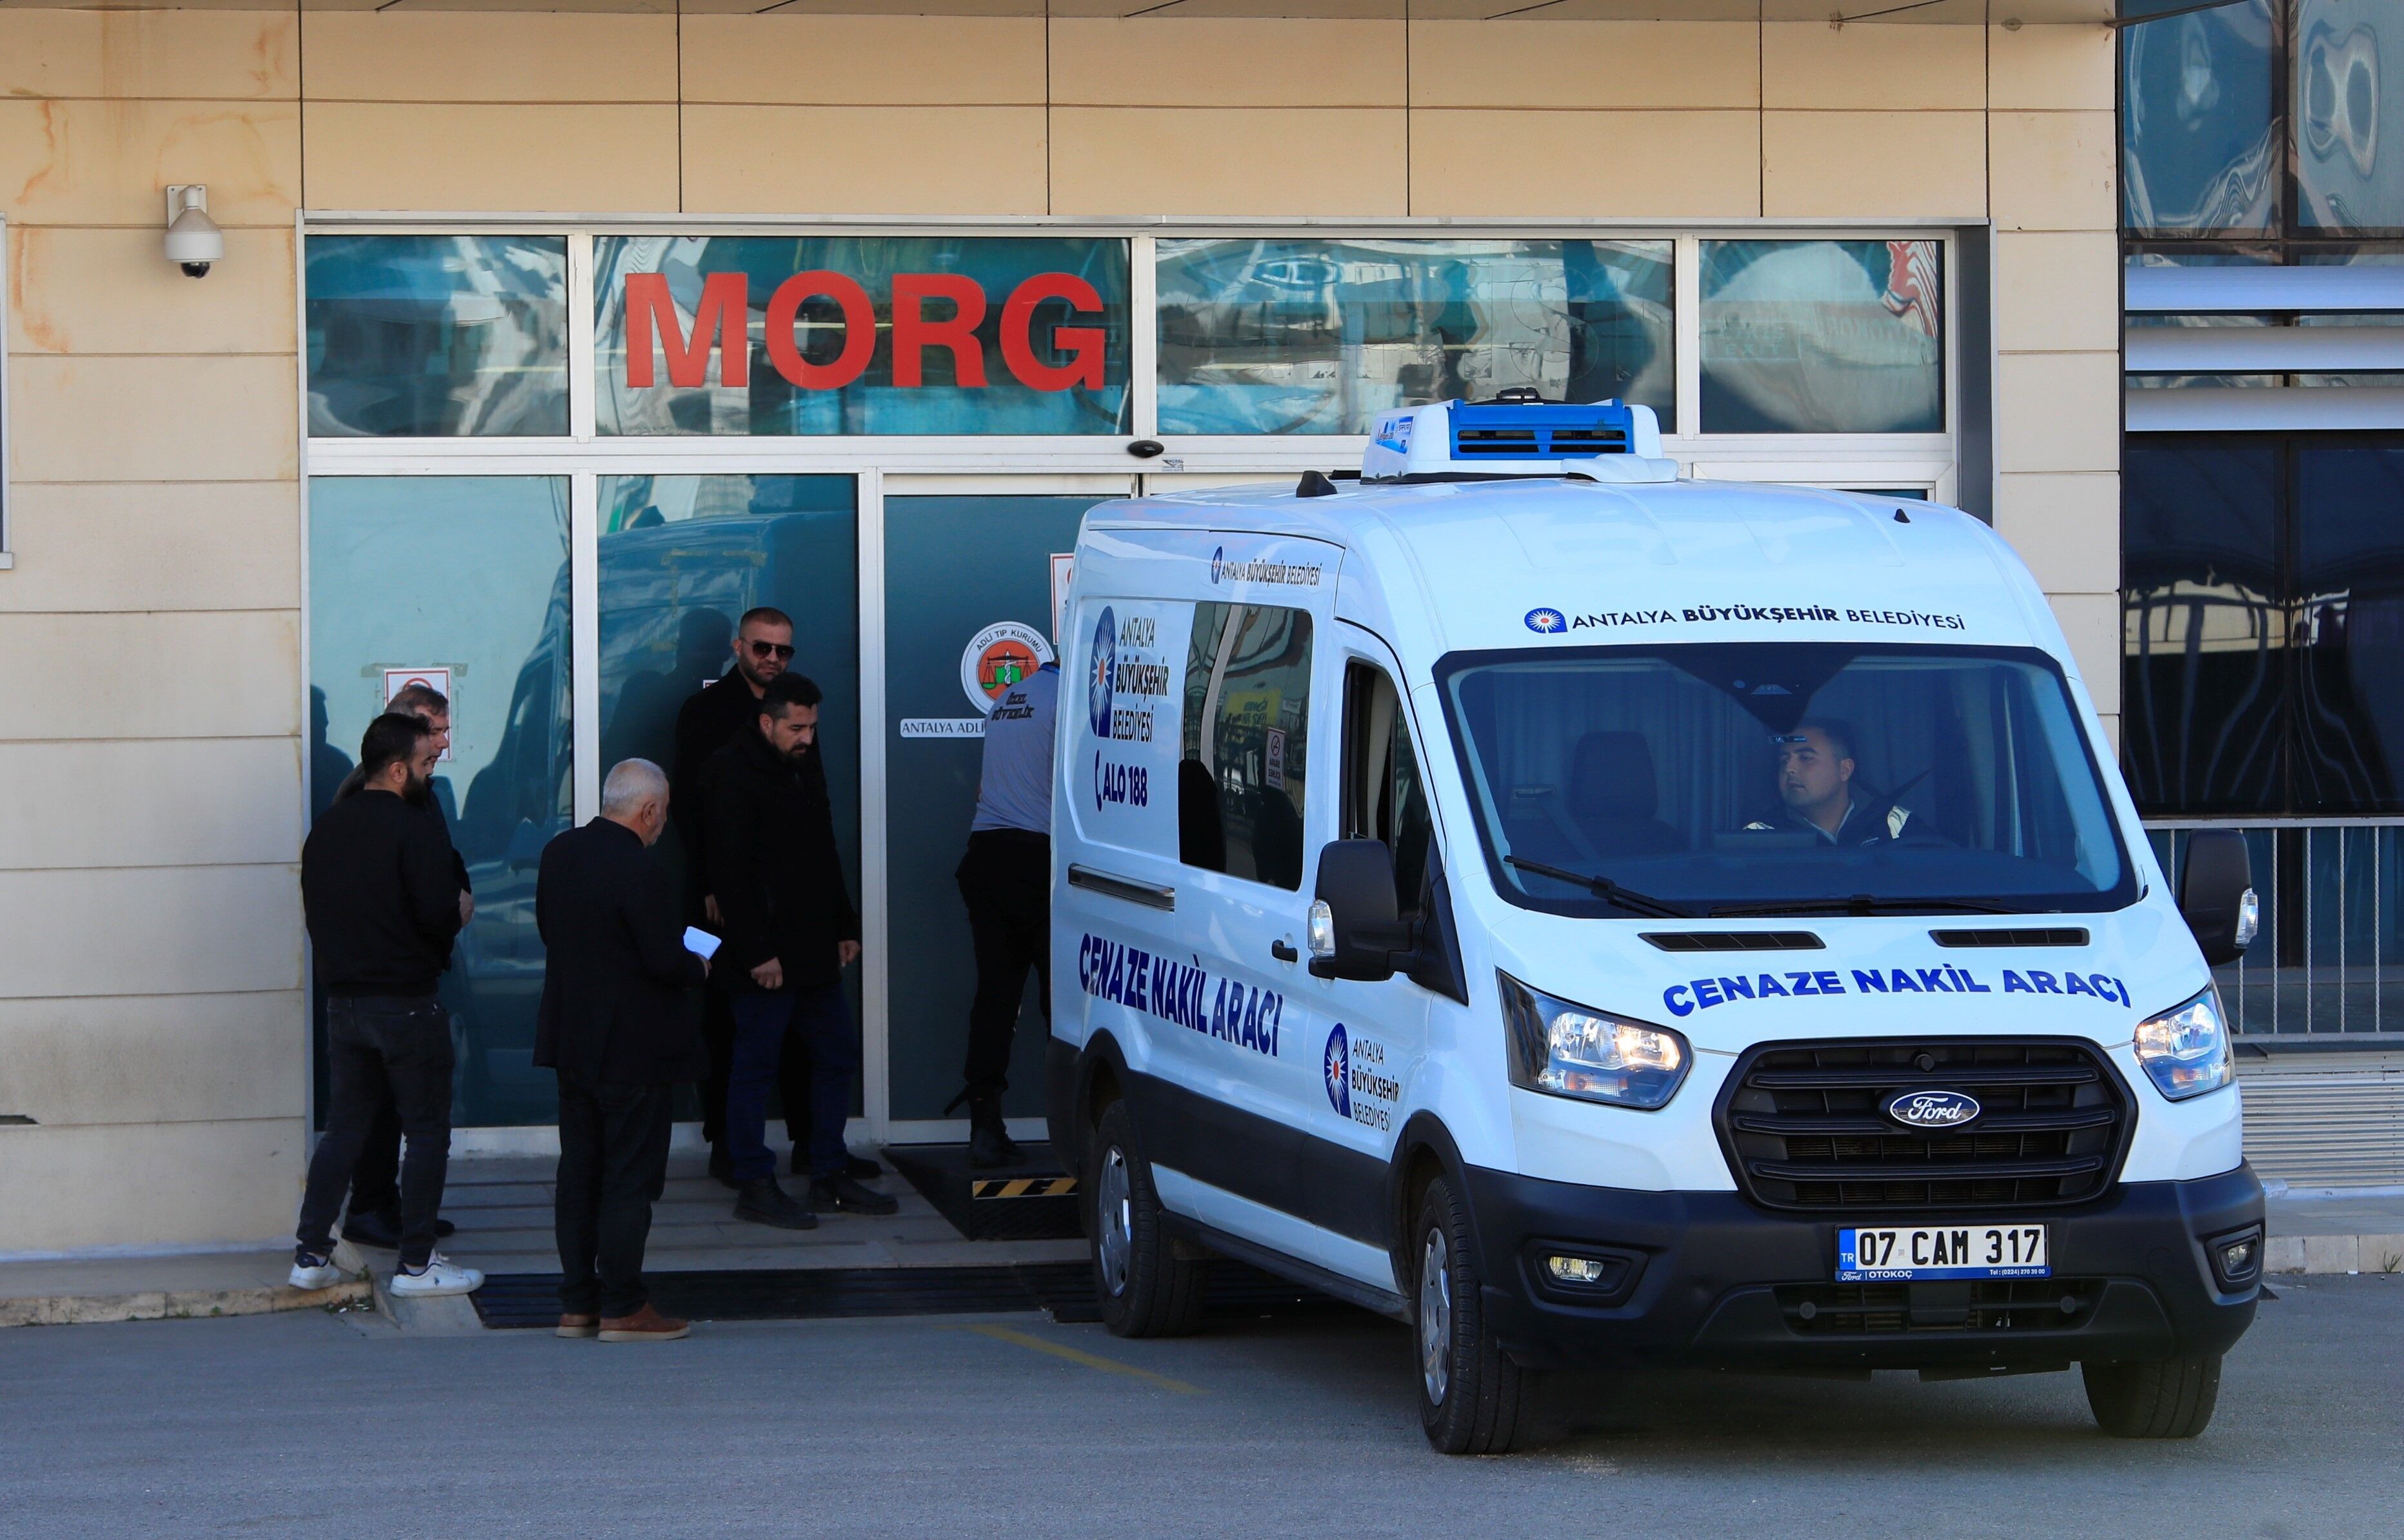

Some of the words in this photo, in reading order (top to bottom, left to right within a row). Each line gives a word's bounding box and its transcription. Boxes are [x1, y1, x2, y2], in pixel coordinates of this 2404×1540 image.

[625, 270, 1106, 391] MORG
[1220, 561, 1246, 580] ANTALYA
[1246, 558, 1286, 587] BÜYÜKŞEHİR
[1286, 562, 1322, 586] BELEDİYESİ
[1118, 617, 1156, 648] ANTALYA
[1572, 609, 1677, 629] ANTALYA
[1682, 604, 1841, 623] BÜYÜKŞEHİR
[1845, 609, 1965, 630] BELEDİYESİ
[977, 633, 993, 651] ADLİ
[995, 629, 1007, 638] TIP
[1011, 629, 1043, 653] KURUMU
[1115, 655, 1169, 703] BÜYÜKŞEHİR
[902, 722, 953, 733] ANTALYA
[957, 720, 985, 733] ADLİ
[1112, 703, 1155, 742] BELEDİYESİ
[1102, 762, 1126, 804] ALO
[1128, 765, 1148, 807] 188
[1079, 933, 1150, 1012] CENAZE
[1151, 953, 1208, 1034] NAKİL
[1211, 977, 1284, 1058] ARACI
[1662, 969, 1847, 1017] CENAZE
[1851, 963, 1992, 994] NAKİL
[2002, 969, 2132, 1009] ARACI
[1353, 1037, 1384, 1065] ANTALYA
[1351, 1065, 1400, 1103] BÜYÜKŞEHİR
[1353, 1101, 1391, 1132] BELEDİYESİ
[1907, 1096, 1963, 1120] Ford
[1841, 1253, 1854, 1262] TR
[1859, 1231, 1896, 1266] 07
[1911, 1230, 1969, 1265] CAM
[1985, 1229, 2041, 1264] 317
[1841, 1271, 1862, 1281] Ford
[1869, 1270, 1912, 1279] OTOKOÇ
